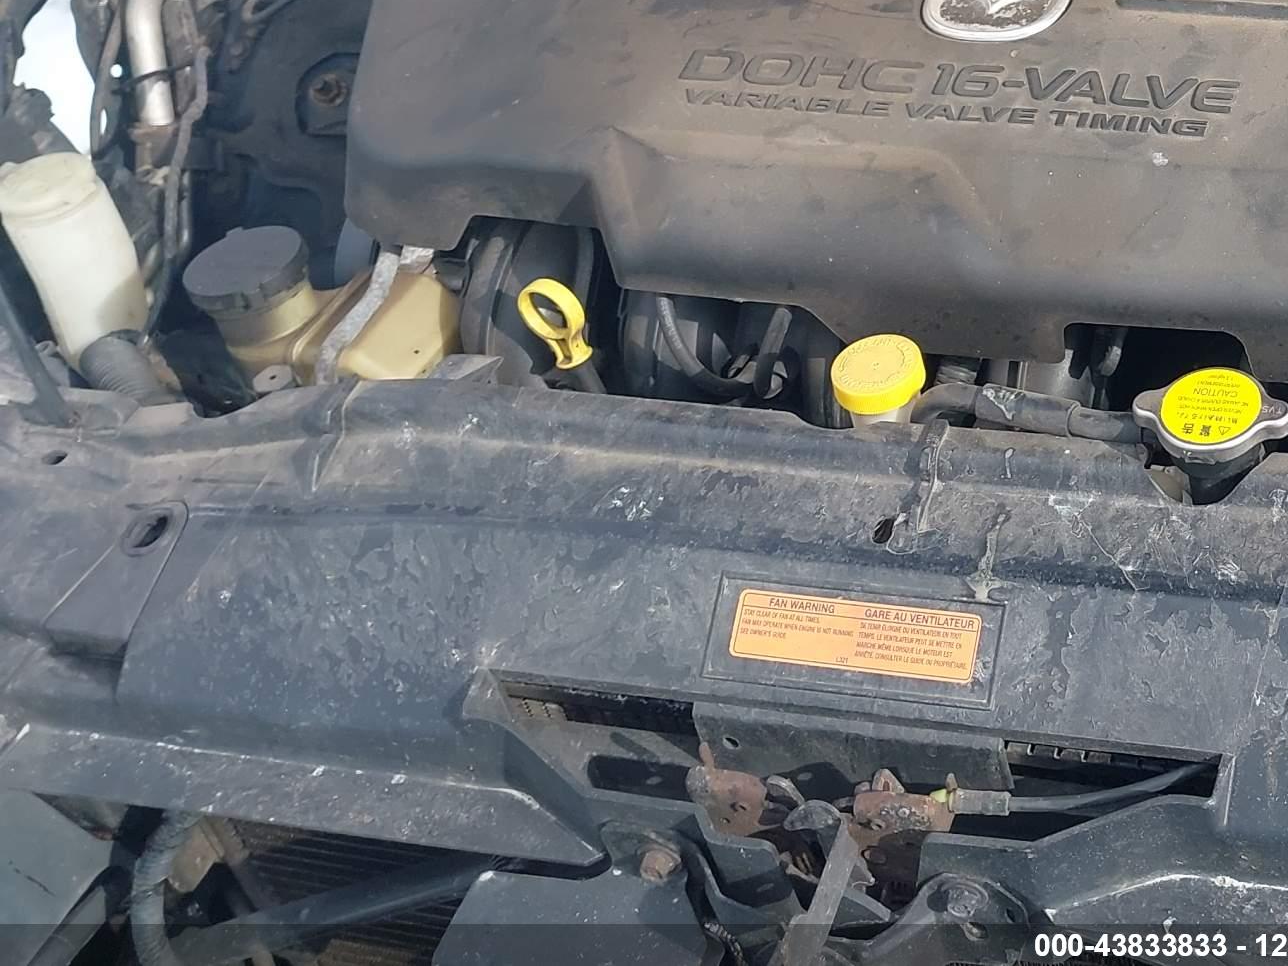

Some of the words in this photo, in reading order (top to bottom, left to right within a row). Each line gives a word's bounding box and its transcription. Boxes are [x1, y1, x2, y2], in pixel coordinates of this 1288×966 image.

[679, 48, 926, 95] DOHC
[930, 63, 1240, 116] 16-VALVE
[685, 87, 890, 119] VARIABLE
[905, 101, 1038, 128] VALVE
[1049, 110, 1208, 137] TIMING
[1193, 387, 1238, 398] CAUTION
[769, 598, 788, 608] FAN
[790, 600, 835, 614] WARNING
[756, 610, 771, 618] CLEAR
[865, 608, 892, 621] GARE
[893, 611, 907, 622] AU
[909, 613, 975, 630] VENTILATEUR
[763, 620, 783, 629] OPERATE
[911, 628, 941, 637] VENTILATEUR
[884, 634, 914, 644] VENTILATEUR
